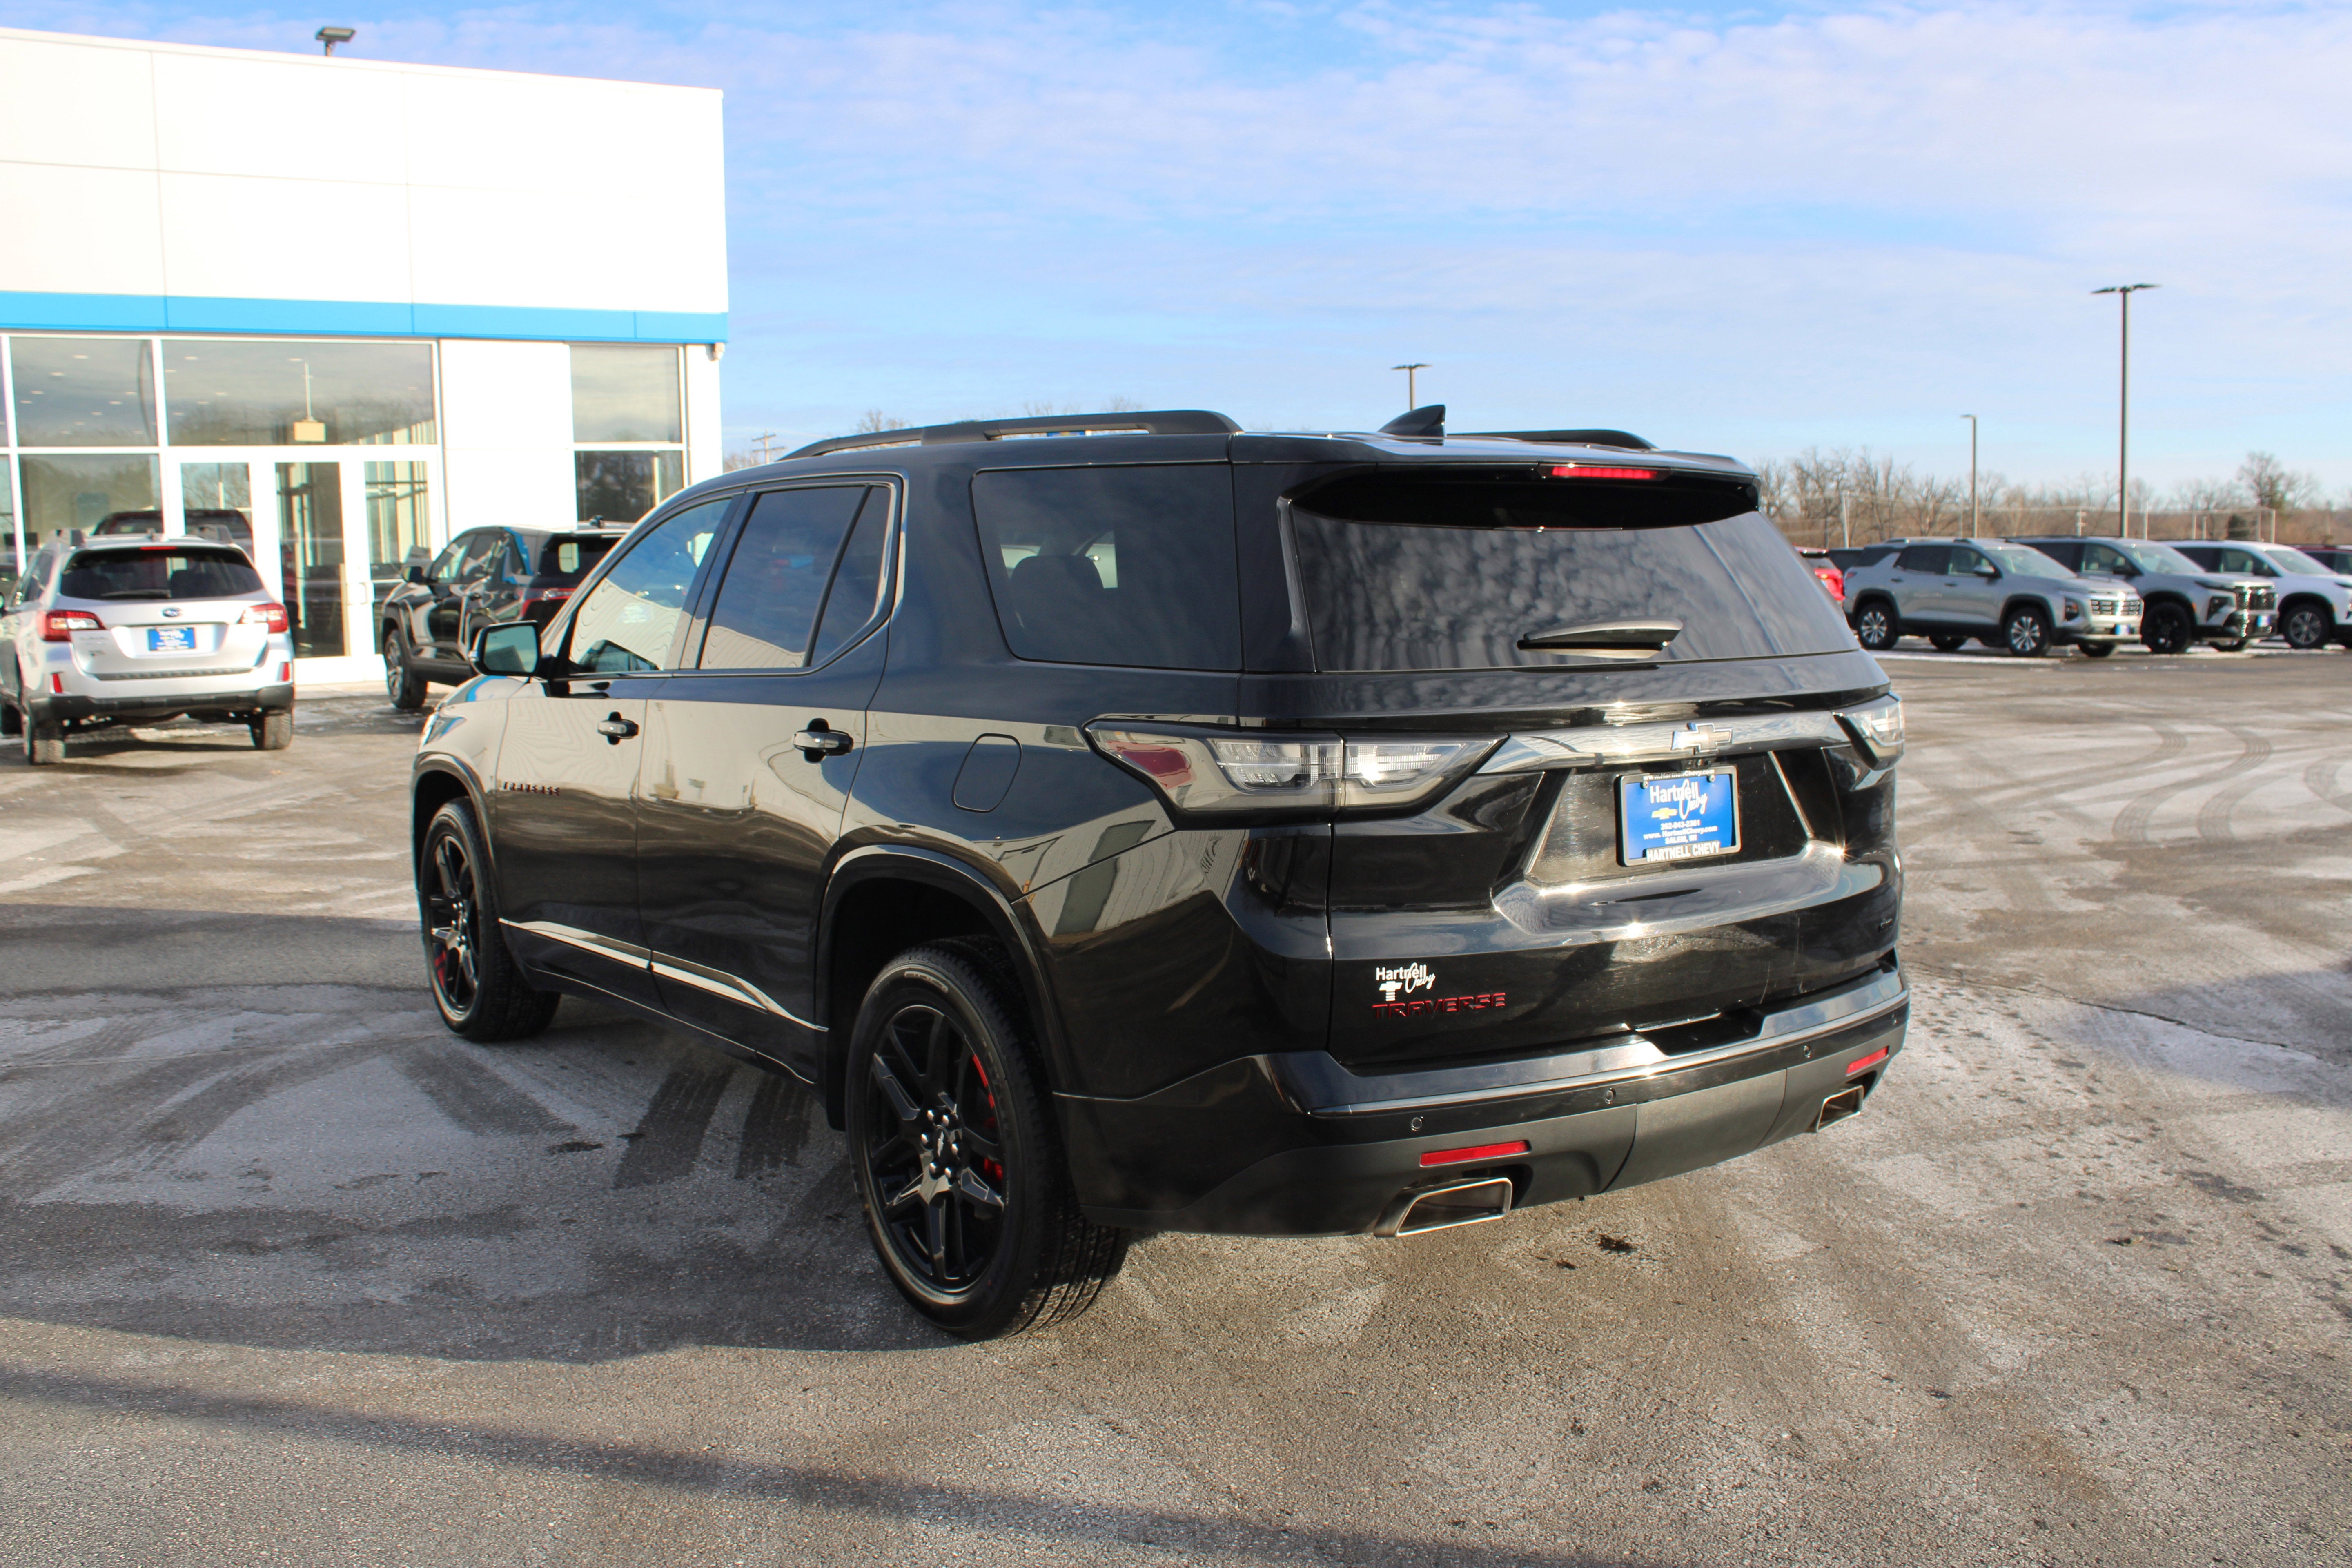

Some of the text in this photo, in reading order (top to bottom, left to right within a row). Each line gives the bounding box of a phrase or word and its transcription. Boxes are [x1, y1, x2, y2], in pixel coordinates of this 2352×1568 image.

[1650, 782, 1700, 803] Hartnell
[1646, 841, 1720, 862] HARTNELL CHEVY
[1376, 964, 1427, 981] Hartnell
[1405, 962, 1435, 993] Chevy
[1372, 992, 1506, 1019] TRAVERSE
